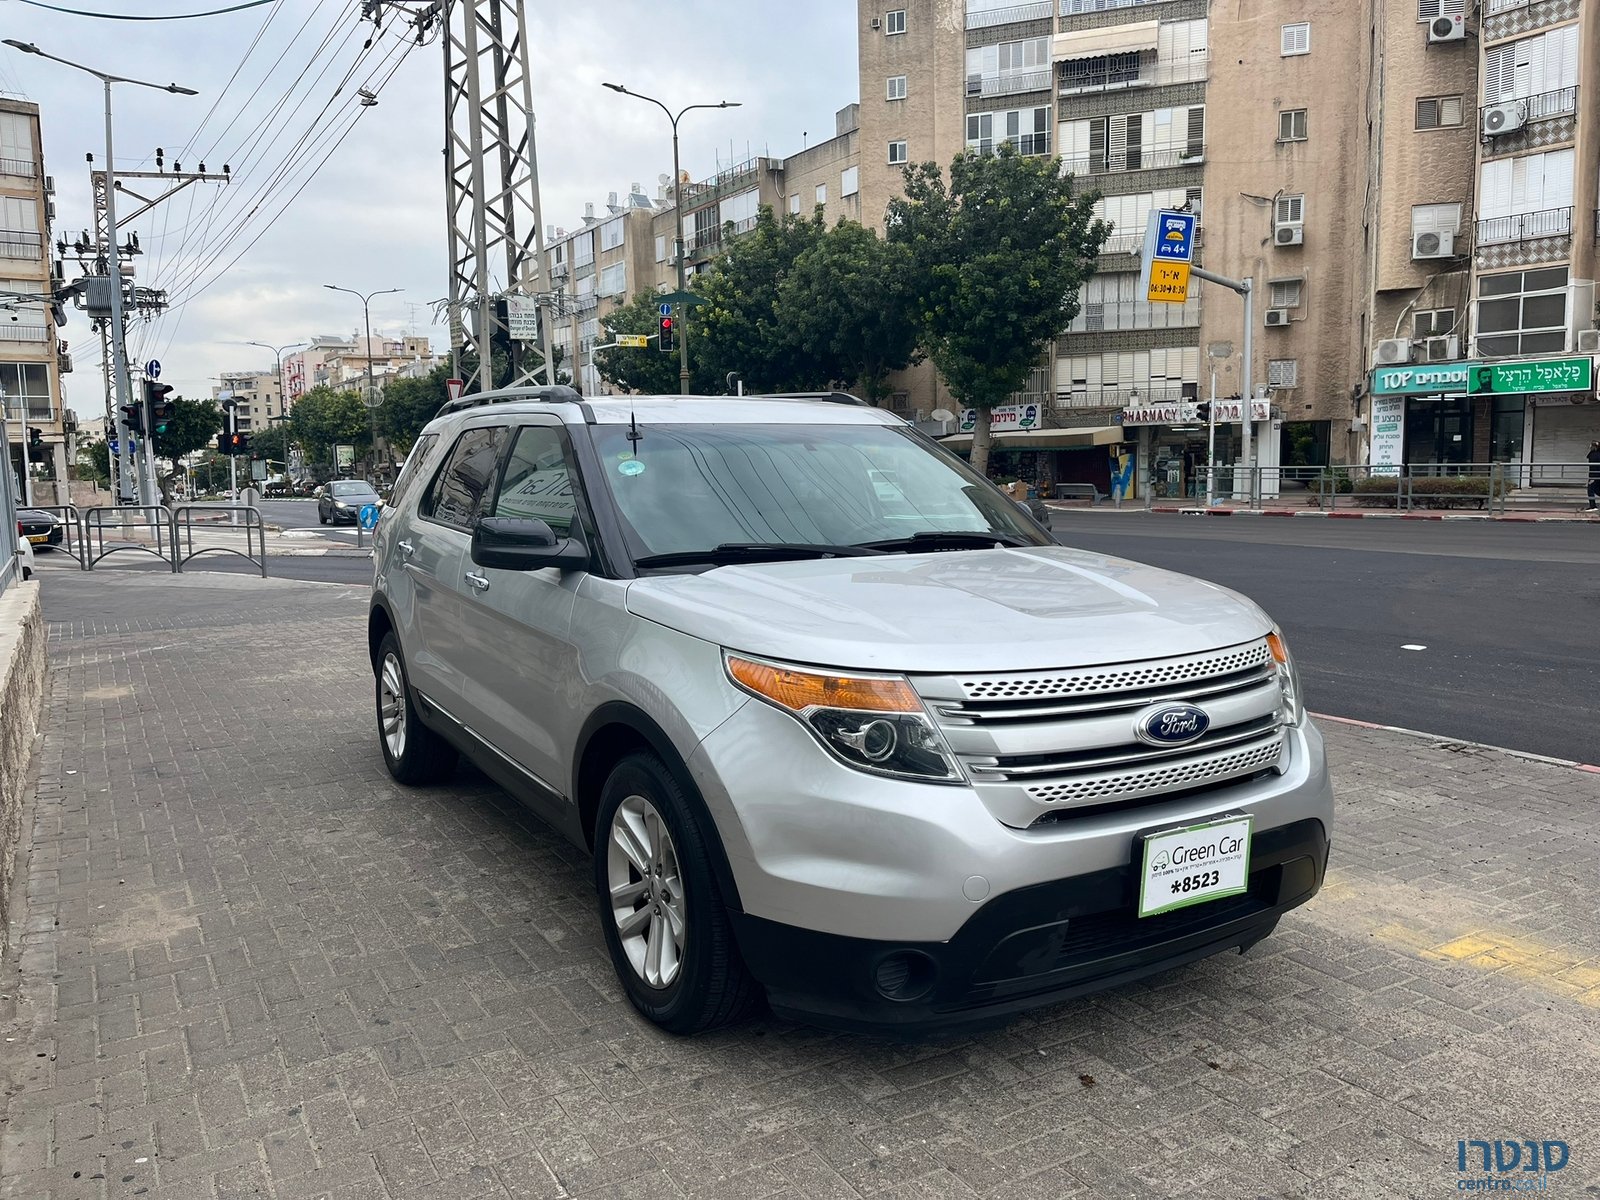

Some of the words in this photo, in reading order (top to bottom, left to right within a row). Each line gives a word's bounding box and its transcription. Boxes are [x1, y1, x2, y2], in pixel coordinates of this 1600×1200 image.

[1173, 244, 1185, 253] 4+
[1150, 284, 1167, 293] 06:30
[1381, 371, 1413, 389] TOP
[1123, 409, 1177, 422] PHARMACY
[1381, 414, 1402, 422] מבצע
[1161, 711, 1198, 736] Ford
[1172, 844, 1215, 865] Green
[1219, 836, 1244, 855] Car
